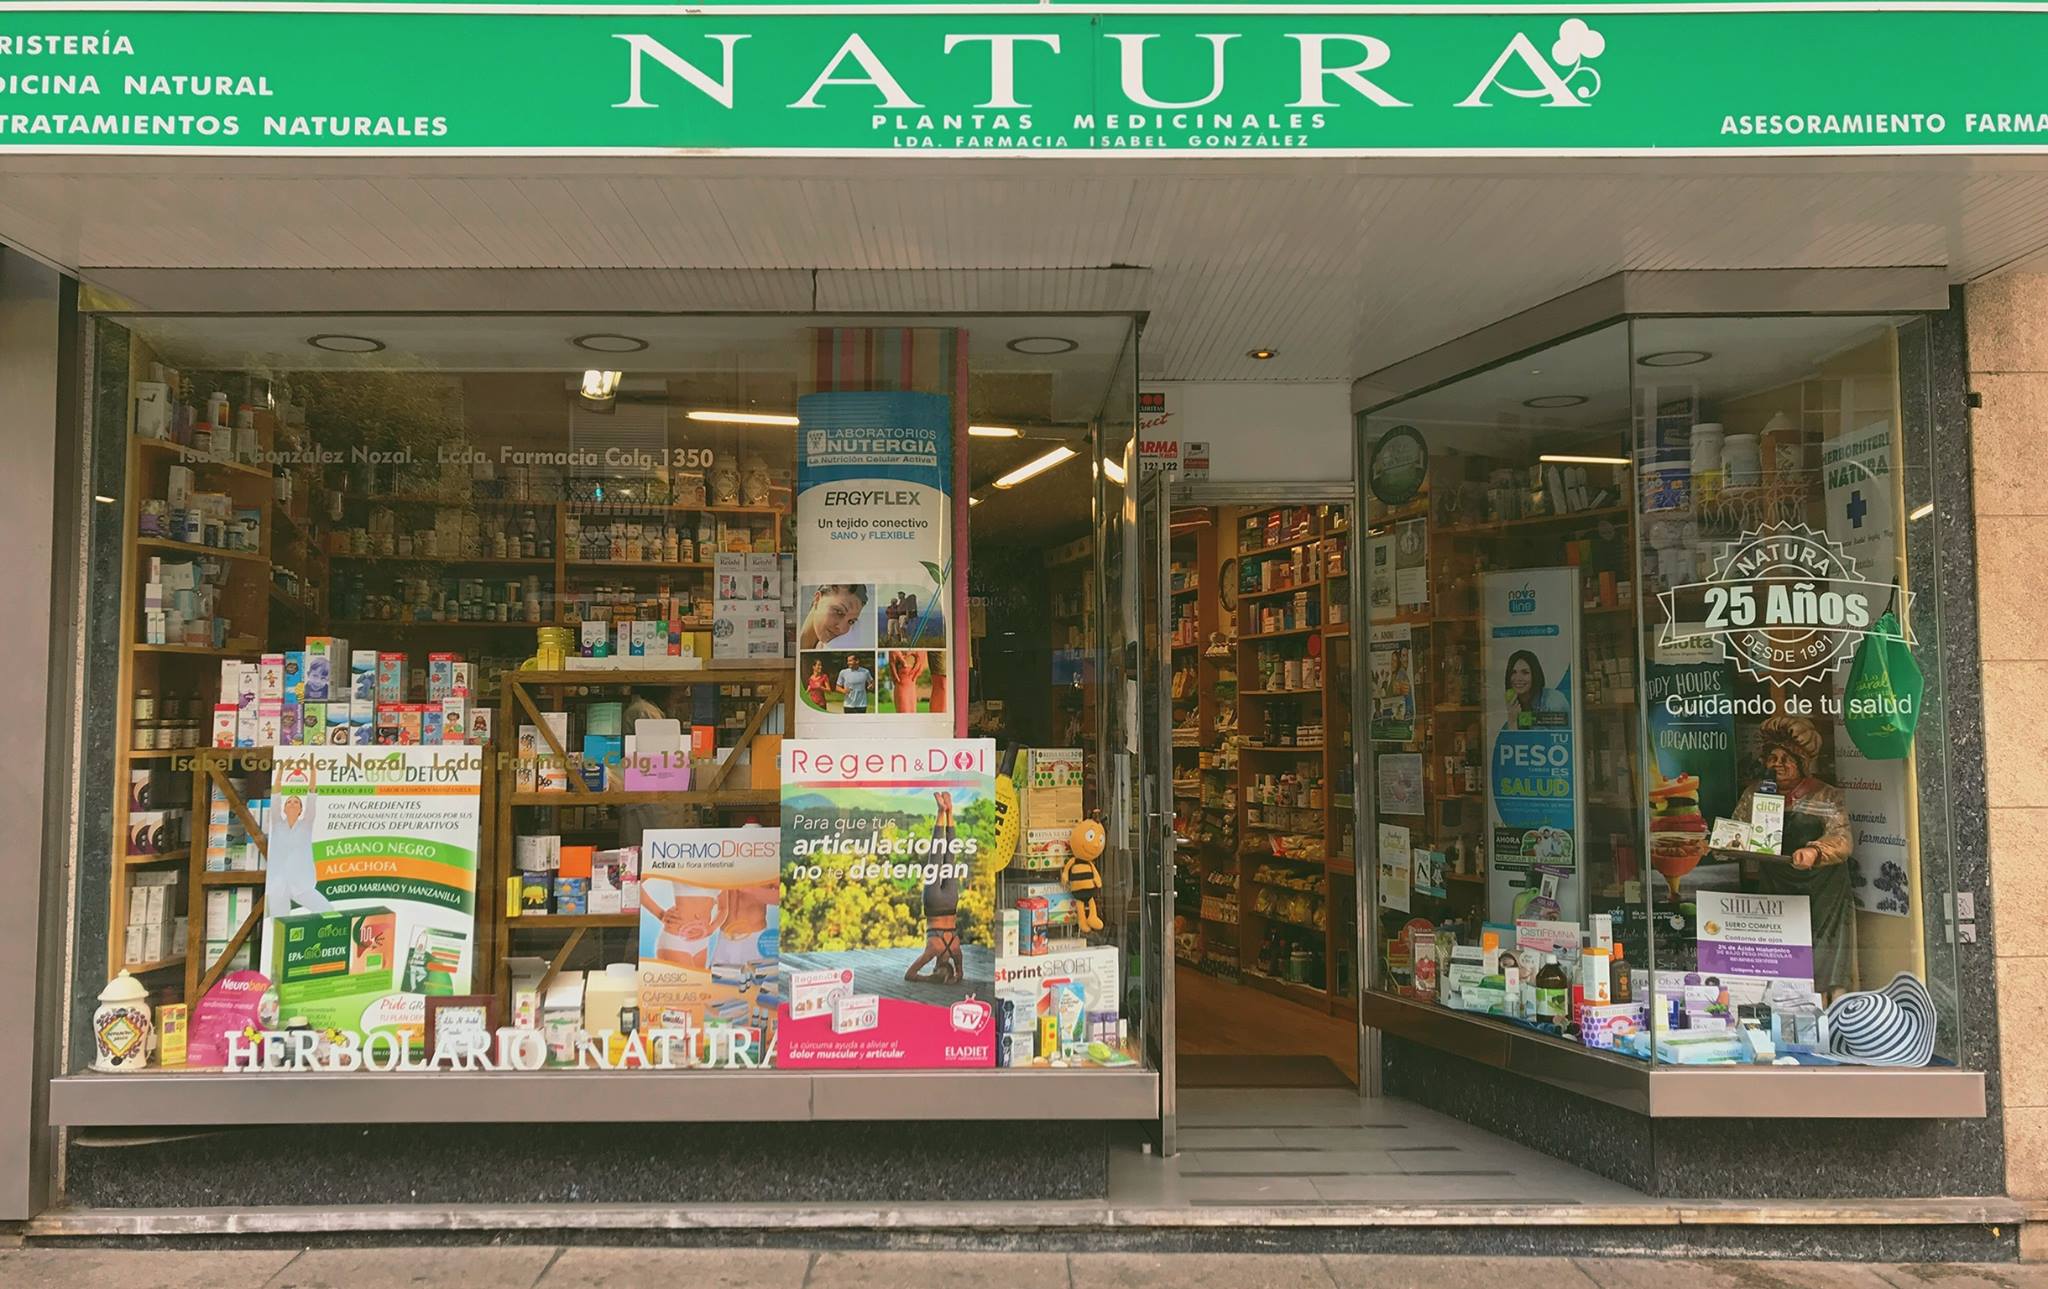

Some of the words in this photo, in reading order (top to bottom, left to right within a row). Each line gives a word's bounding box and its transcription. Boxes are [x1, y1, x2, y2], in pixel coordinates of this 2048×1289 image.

[0, 29, 134, 56] RISTERÍA
[611, 33, 1598, 110] NATURA
[124, 75, 273, 96] NATURAL
[0, 114, 240, 136] TRATAMIENTOS
[263, 115, 448, 137] NATURALES
[872, 114, 1033, 130] PLANTAS
[1074, 114, 1326, 130] MEDICINALES
[1721, 113, 1947, 135] ASESORAMIENTO
[1965, 113, 2048, 133] FARMA
[893, 135, 942, 147] LDA.
[956, 135, 1068, 148] FARMACIA
[1090, 135, 1168, 148] ISABEL
[1188, 132, 1310, 148] GONZÁLEZ
[827, 429, 937, 440] LABORATORIOS
[826, 439, 937, 454] NUTERGIA
[352, 446, 418, 464] Nozal.
[437, 446, 493, 465] Lcda.
[500, 446, 599, 466] Farmacia
[821, 455, 863, 464] Nutrición
[866, 455, 896, 464] Celular
[825, 490, 921, 506] ERGYFLEX
[818, 519, 833, 529] Un
[837, 518, 869, 531] tejido
[872, 518, 928, 529] conectivo
[831, 531, 858, 540] SANO
[869, 531, 916, 540] FLEXIBLE
[1736, 543, 1831, 577] NATURA
[1703, 586, 1757, 629] 25
[1765, 582, 1870, 628] Años
[1741, 633, 1796, 663] DESDE
[1800, 633, 1834, 663] 1991
[1675, 670, 1721, 695] HOURS
[1665, 694, 1777, 715] Cuidando
[1784, 694, 1813, 715] de
[1820, 696, 1842, 715] tu
[1850, 693, 1912, 715] salud
[1551, 733, 1569, 744] TU
[1660, 729, 1728, 751] ORGANISMO
[170, 752, 233, 772] Isabel
[240, 752, 338, 772] González
[604, 750, 717, 773] Colg.135
[1500, 744, 1569, 767] PESO
[1551, 768, 1569, 776] ES
[1501, 777, 1569, 797] SALUD
[347, 801, 421, 810] INGREDIENTES
[327, 820, 387, 831] BENEFICIOS
[388, 820, 460, 831] DEPURATIVOS
[793, 815, 829, 830] Para
[834, 817, 866, 831] que
[872, 817, 896, 830] tus
[325, 841, 384, 857] RÁBANO
[387, 842, 436, 858] NEGRO
[792, 831, 978, 856] articulaciones
[325, 861, 397, 875] ALCACHOFA
[652, 861, 676, 869] Activa
[792, 865, 822, 880] no
[826, 867, 843, 879] te
[849, 857, 969, 885] detengan
[326, 885, 356, 896] CARDO
[358, 883, 399, 893] MARIANO
[407, 886, 461, 904] MANZANILLA
[221, 978, 268, 992] Neuroben
[224, 1029, 548, 1072] HERBOLARIO
[789, 1049, 814, 1059] dolor
[817, 1049, 859, 1059] muscular
[866, 1049, 904, 1059] articular
[945, 1046, 989, 1058] ELADIET
